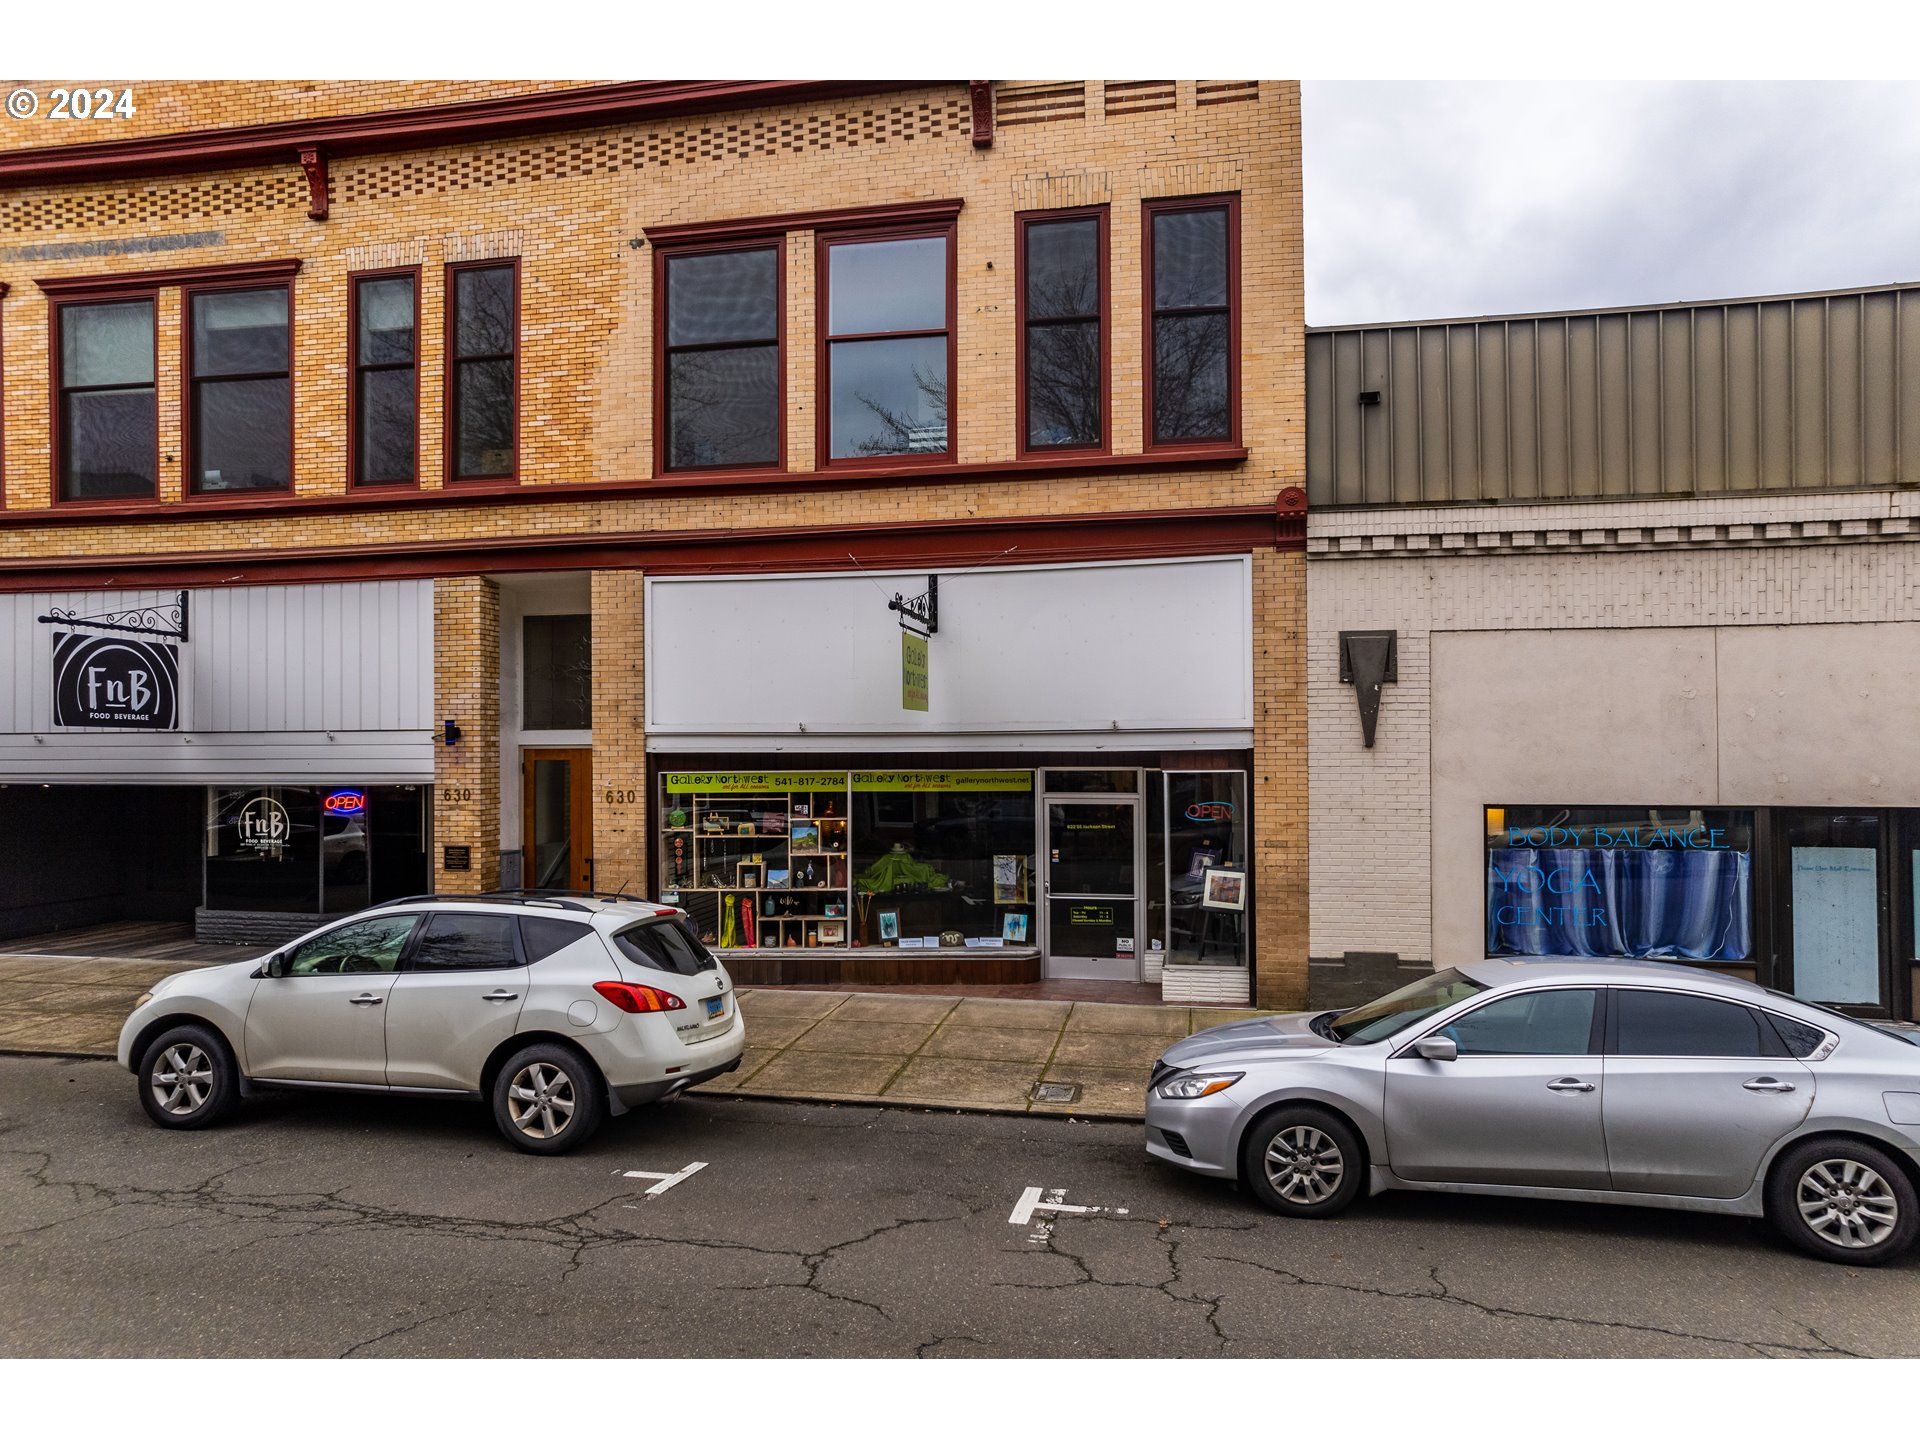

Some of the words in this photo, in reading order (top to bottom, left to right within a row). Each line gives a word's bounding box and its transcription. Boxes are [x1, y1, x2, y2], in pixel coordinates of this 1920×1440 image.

[88, 666, 151, 711] FnB
[775, 777, 845, 786] 541-817-2784
[955, 777, 1029, 786] gallerynorthwest.net
[325, 795, 365, 810] OPEN
[444, 788, 471, 802] 630
[606, 790, 636, 804] 630
[1187, 804, 1233, 820] OPEN
[245, 811, 284, 838] FnB
[1509, 826, 1585, 847] BODY
[1595, 827, 1731, 849] BALANCE
[1493, 866, 1602, 895] YOGA
[1496, 905, 1608, 927] CENTER
